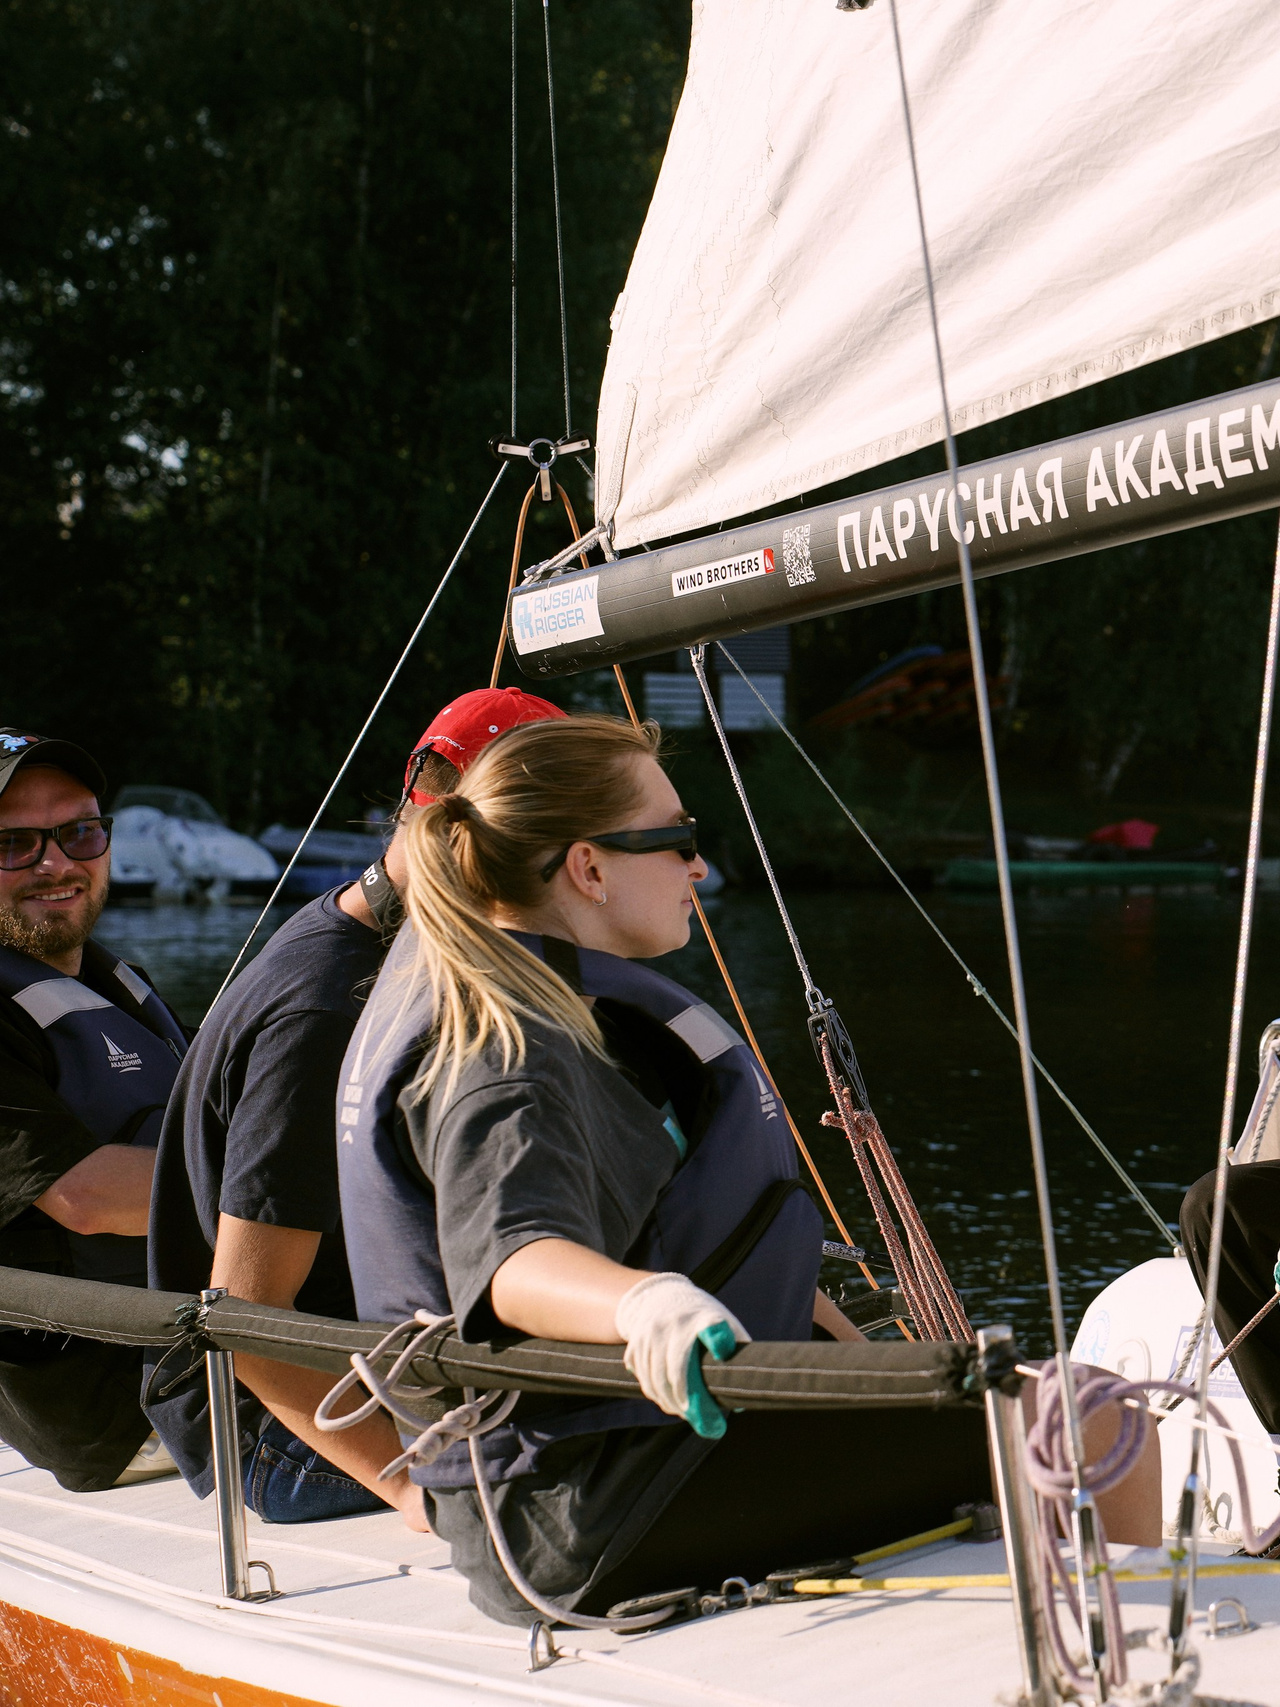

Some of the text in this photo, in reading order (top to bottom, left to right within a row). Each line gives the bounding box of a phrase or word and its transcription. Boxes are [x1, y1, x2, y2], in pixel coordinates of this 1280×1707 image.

[837, 456, 1070, 574] ПАРУСНАЯ
[676, 556, 760, 592] WIND BROTHERS
[534, 582, 595, 614] RUSSIAN
[534, 607, 586, 636] RIGGER
